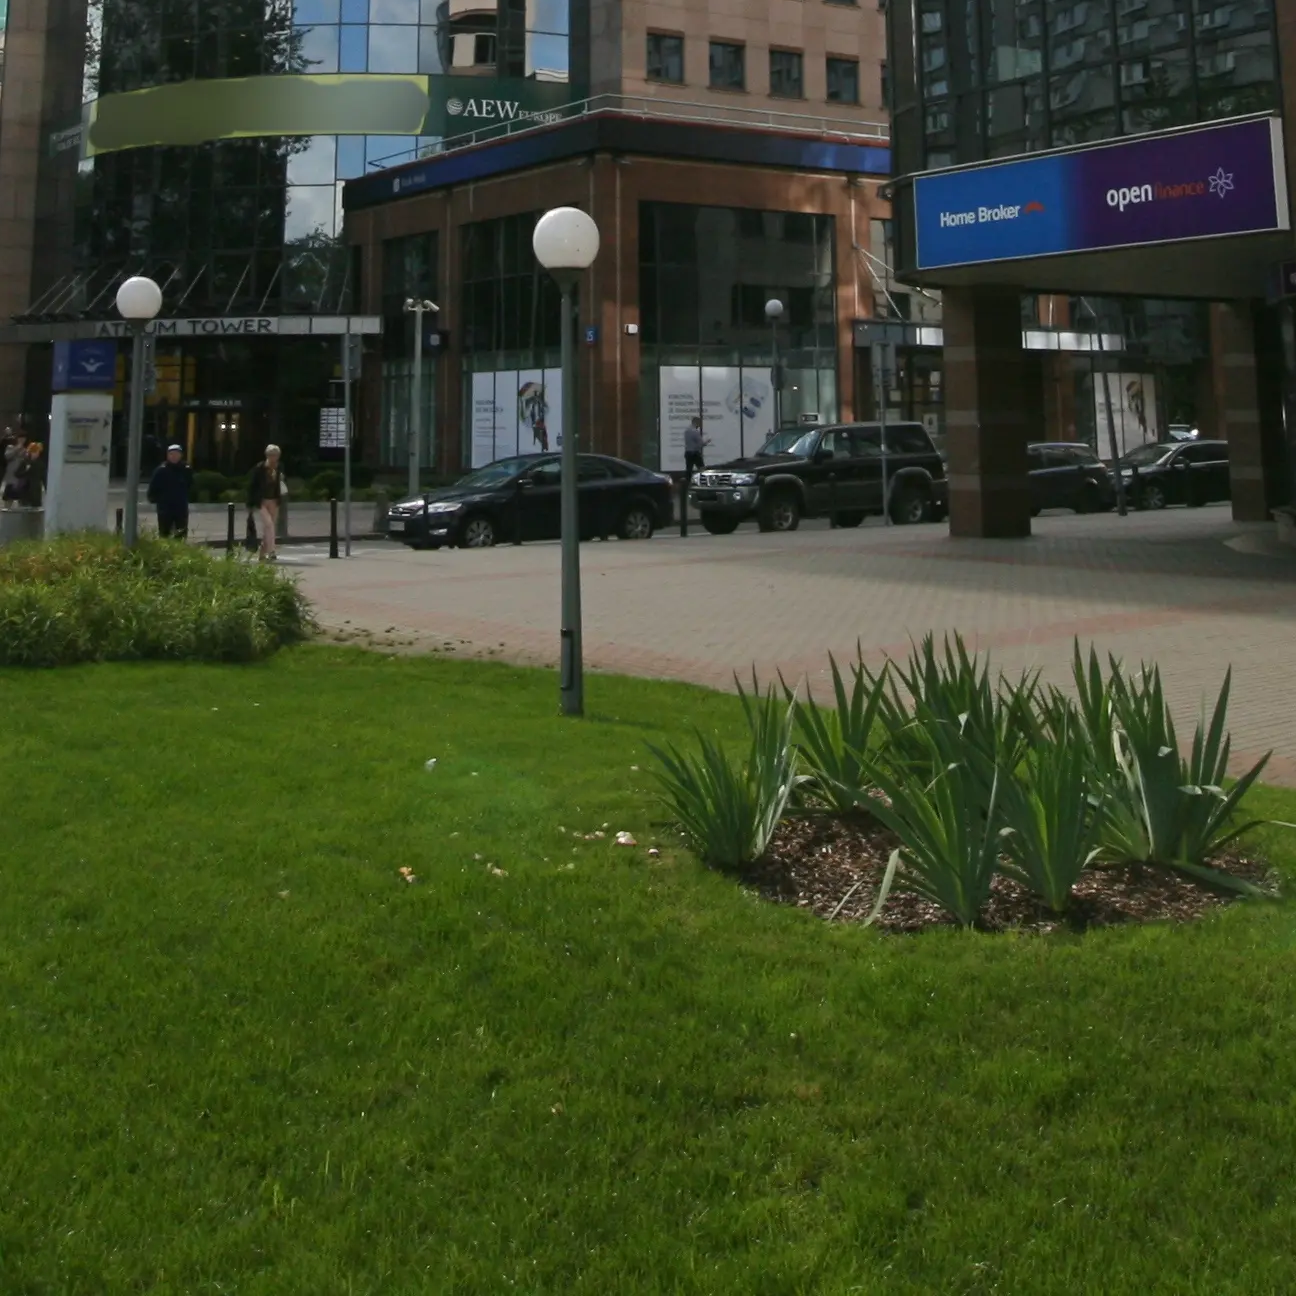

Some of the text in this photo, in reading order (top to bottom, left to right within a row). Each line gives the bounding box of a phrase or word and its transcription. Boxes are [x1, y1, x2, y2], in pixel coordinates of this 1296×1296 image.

[463, 99, 520, 119] AEW
[940, 203, 1021, 228] Home Broker
[99, 319, 272, 336] ATRUM TOWER
